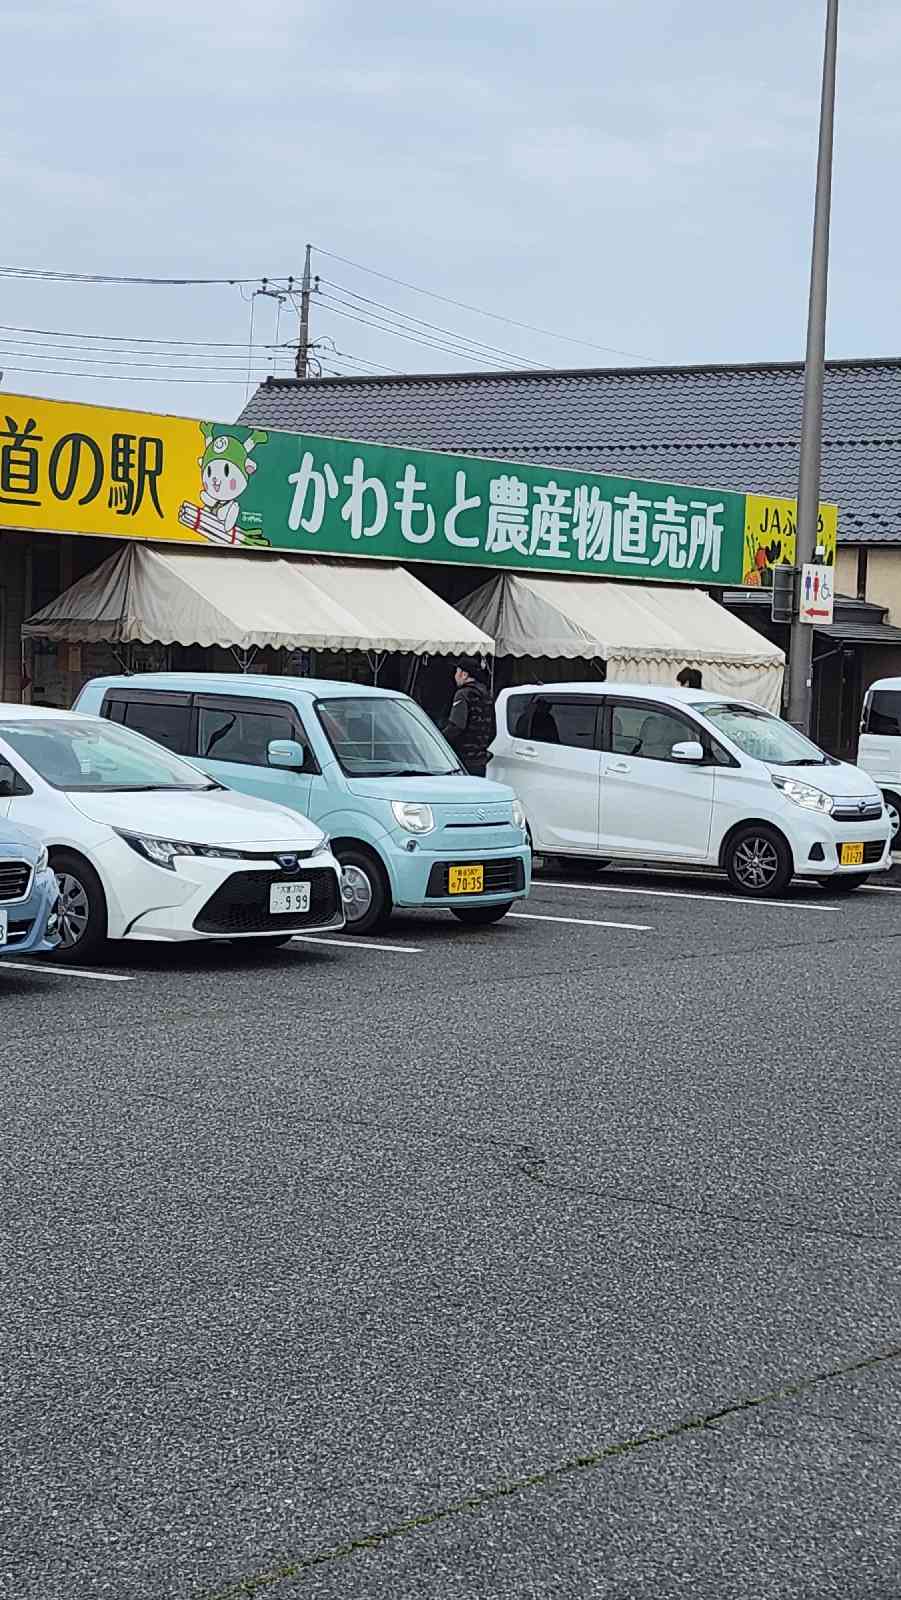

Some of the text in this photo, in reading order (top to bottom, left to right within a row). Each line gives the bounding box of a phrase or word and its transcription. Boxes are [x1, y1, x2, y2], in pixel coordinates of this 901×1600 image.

[0, 416, 724, 573] 道の駅 かわもと農産物直売所
[456, 876, 482, 891] 70-35
